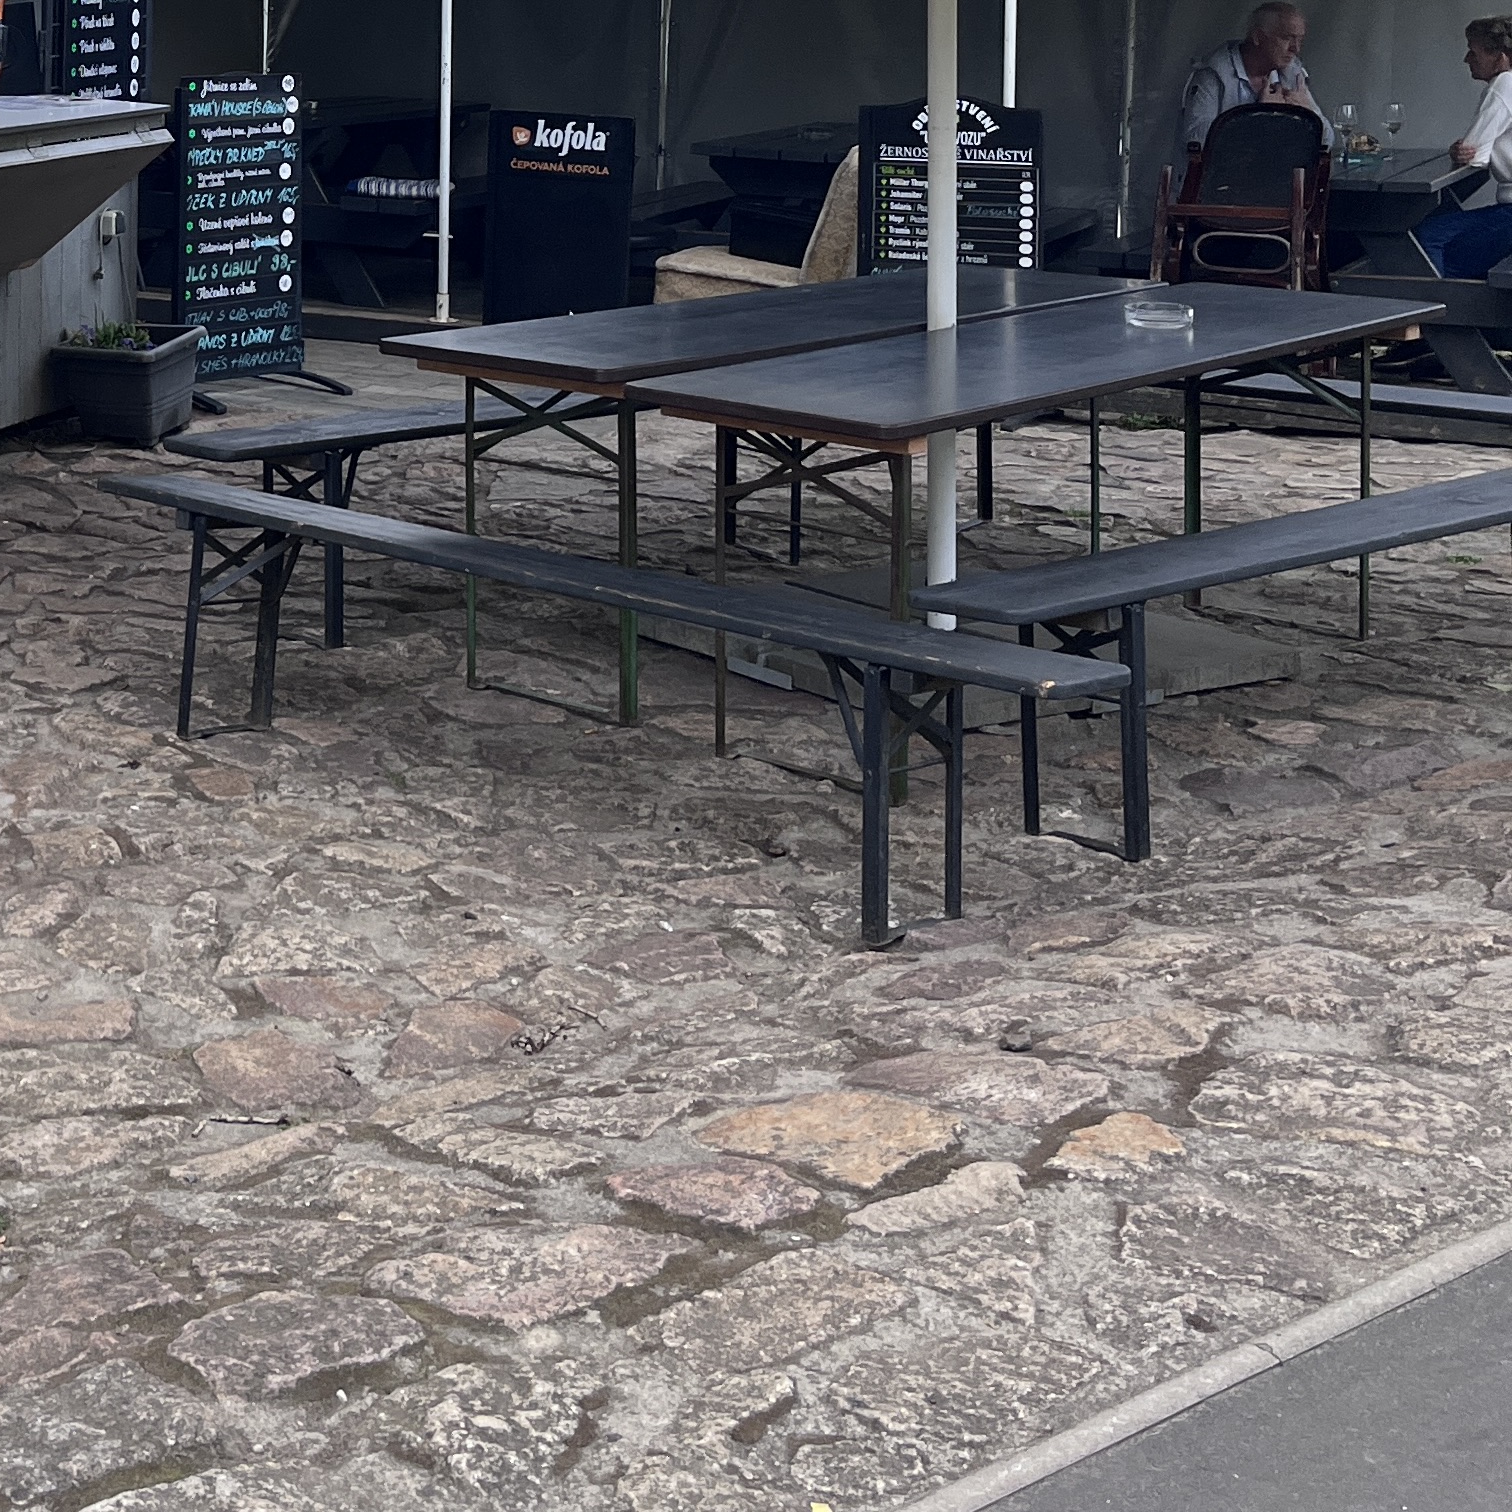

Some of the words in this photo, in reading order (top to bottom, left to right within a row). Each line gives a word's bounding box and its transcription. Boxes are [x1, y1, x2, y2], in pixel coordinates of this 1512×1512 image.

[912, 99, 1000, 133] OBSTVENÍ
[534, 119, 607, 156] kofola
[510, 157, 565, 172] ČEPOVANÁ
[567, 163, 609, 175] KOFOLA
[964, 147, 1033, 161] VINAŘSTVÍ
